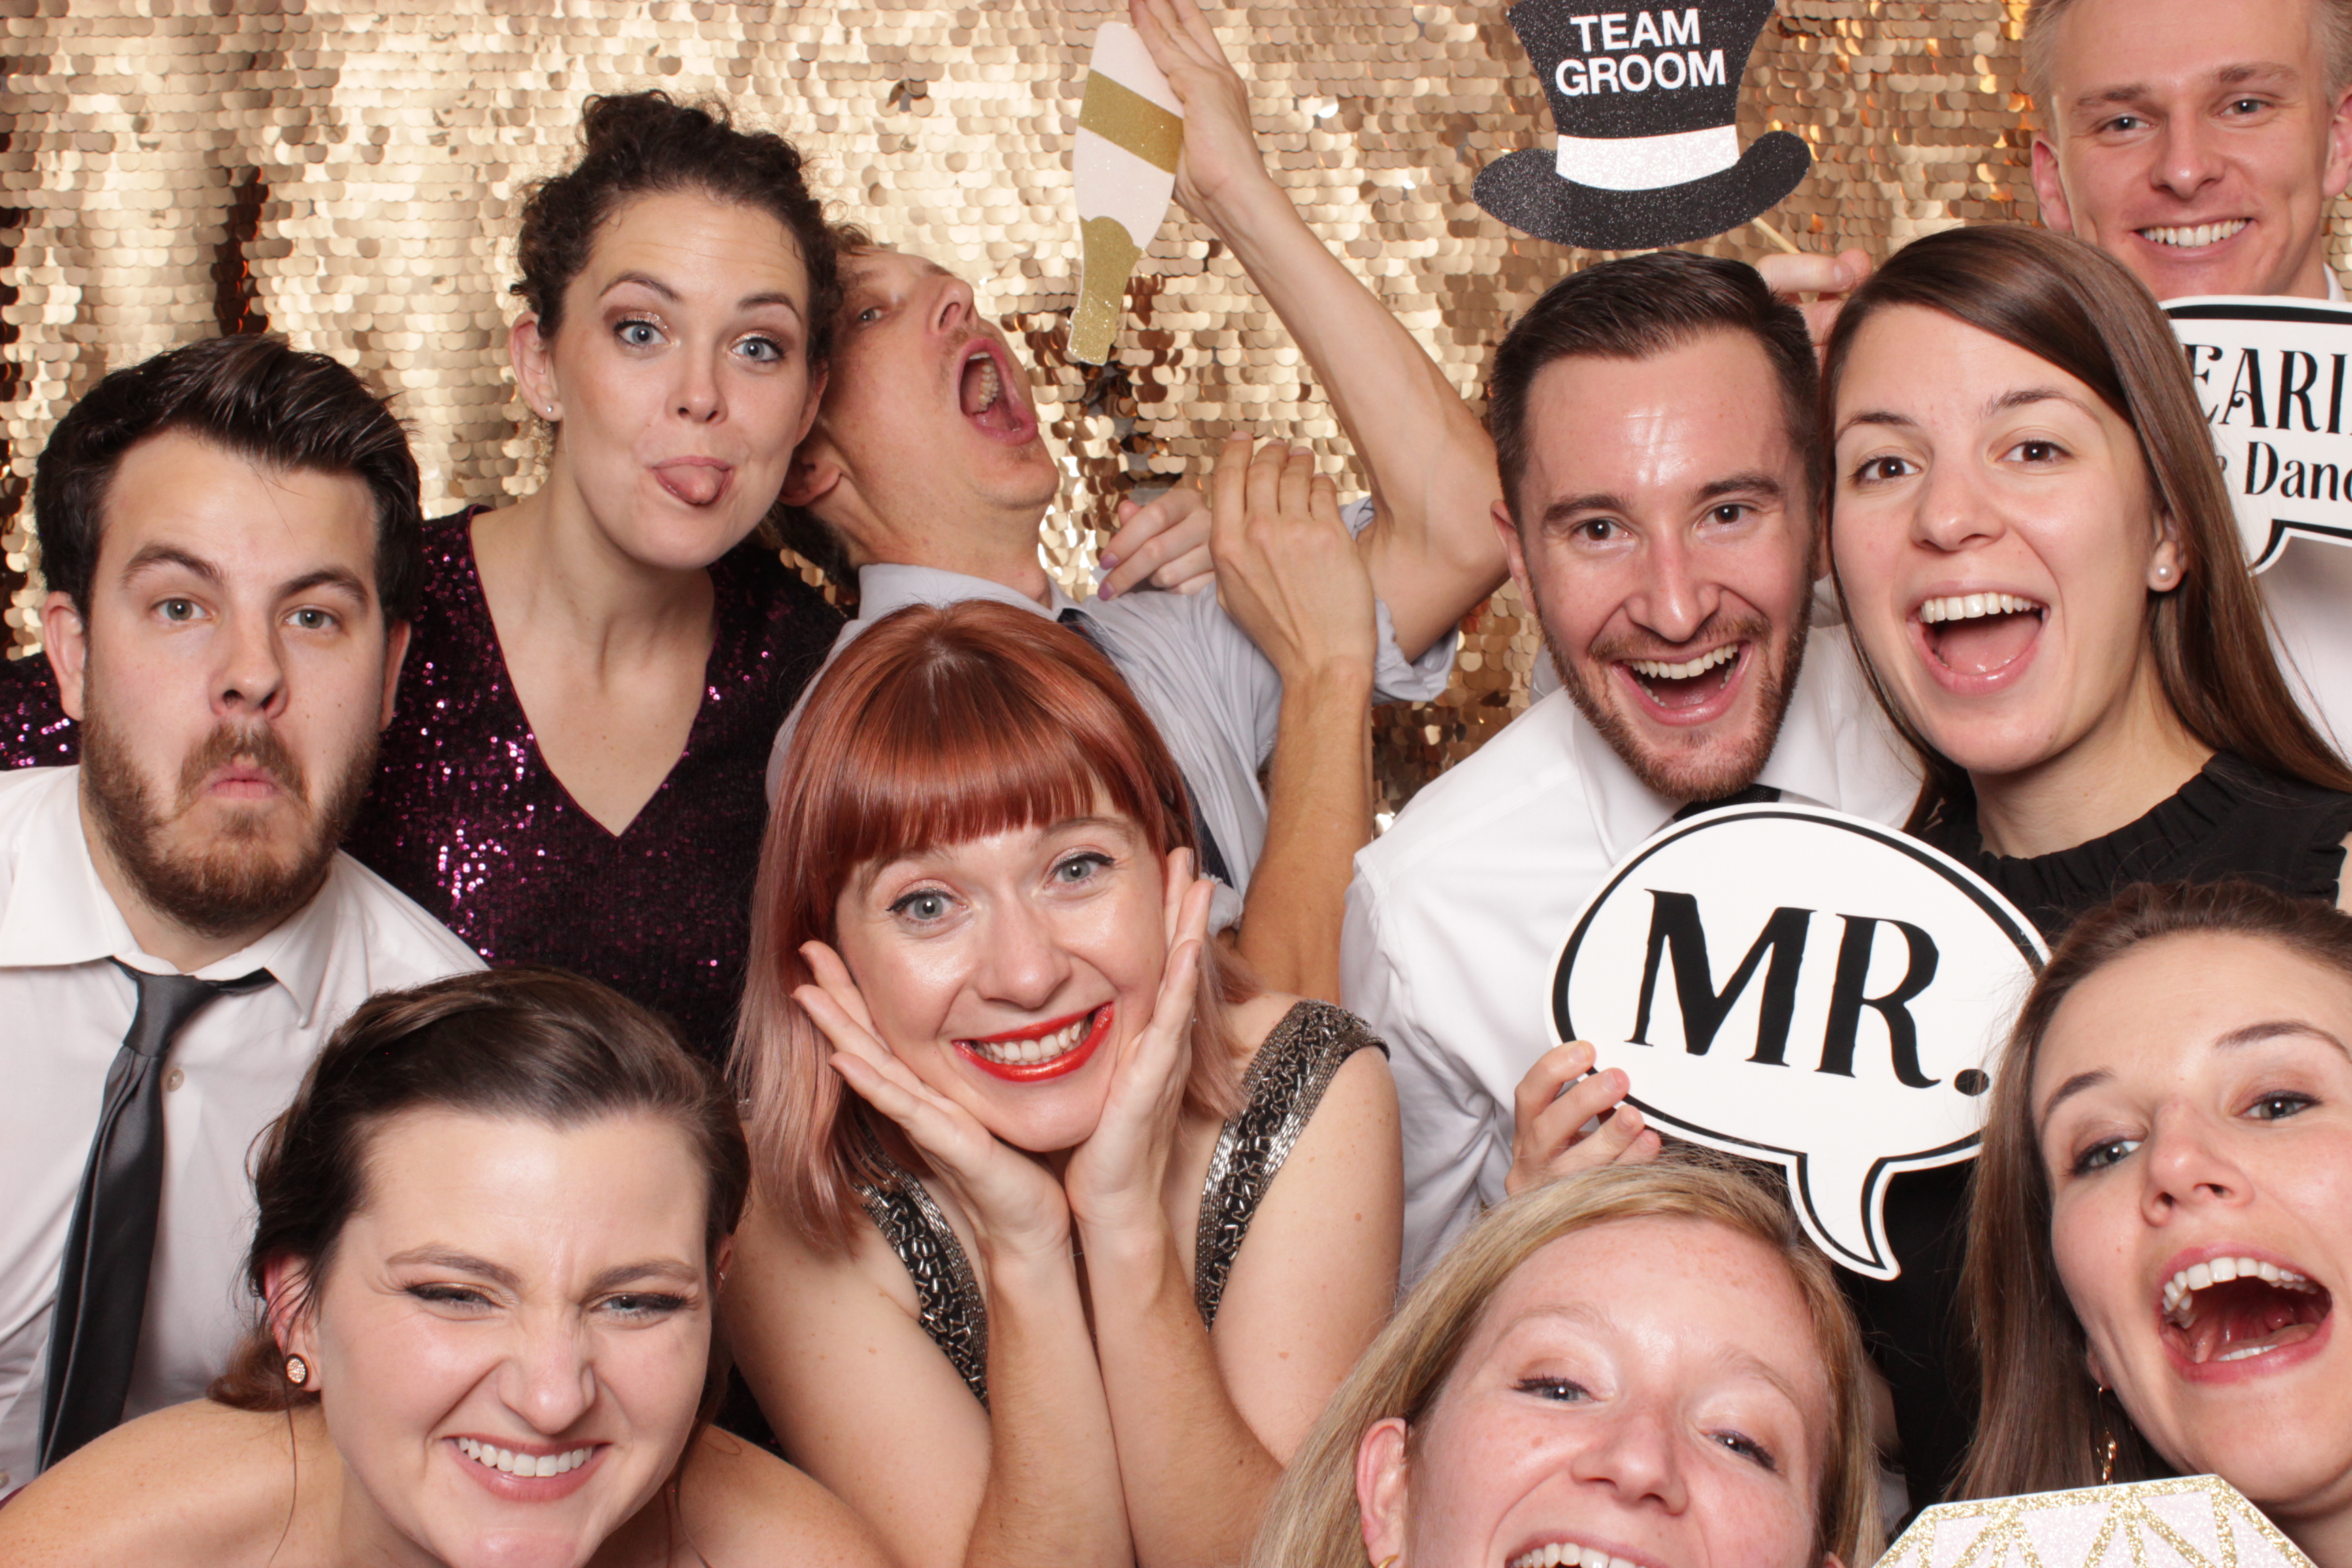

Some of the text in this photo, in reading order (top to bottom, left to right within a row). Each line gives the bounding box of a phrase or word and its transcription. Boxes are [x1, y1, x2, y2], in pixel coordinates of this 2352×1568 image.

[1569, 7, 1701, 52] TEAM
[1554, 48, 1727, 97] GROOM
[1624, 888, 1990, 1097] MR.
